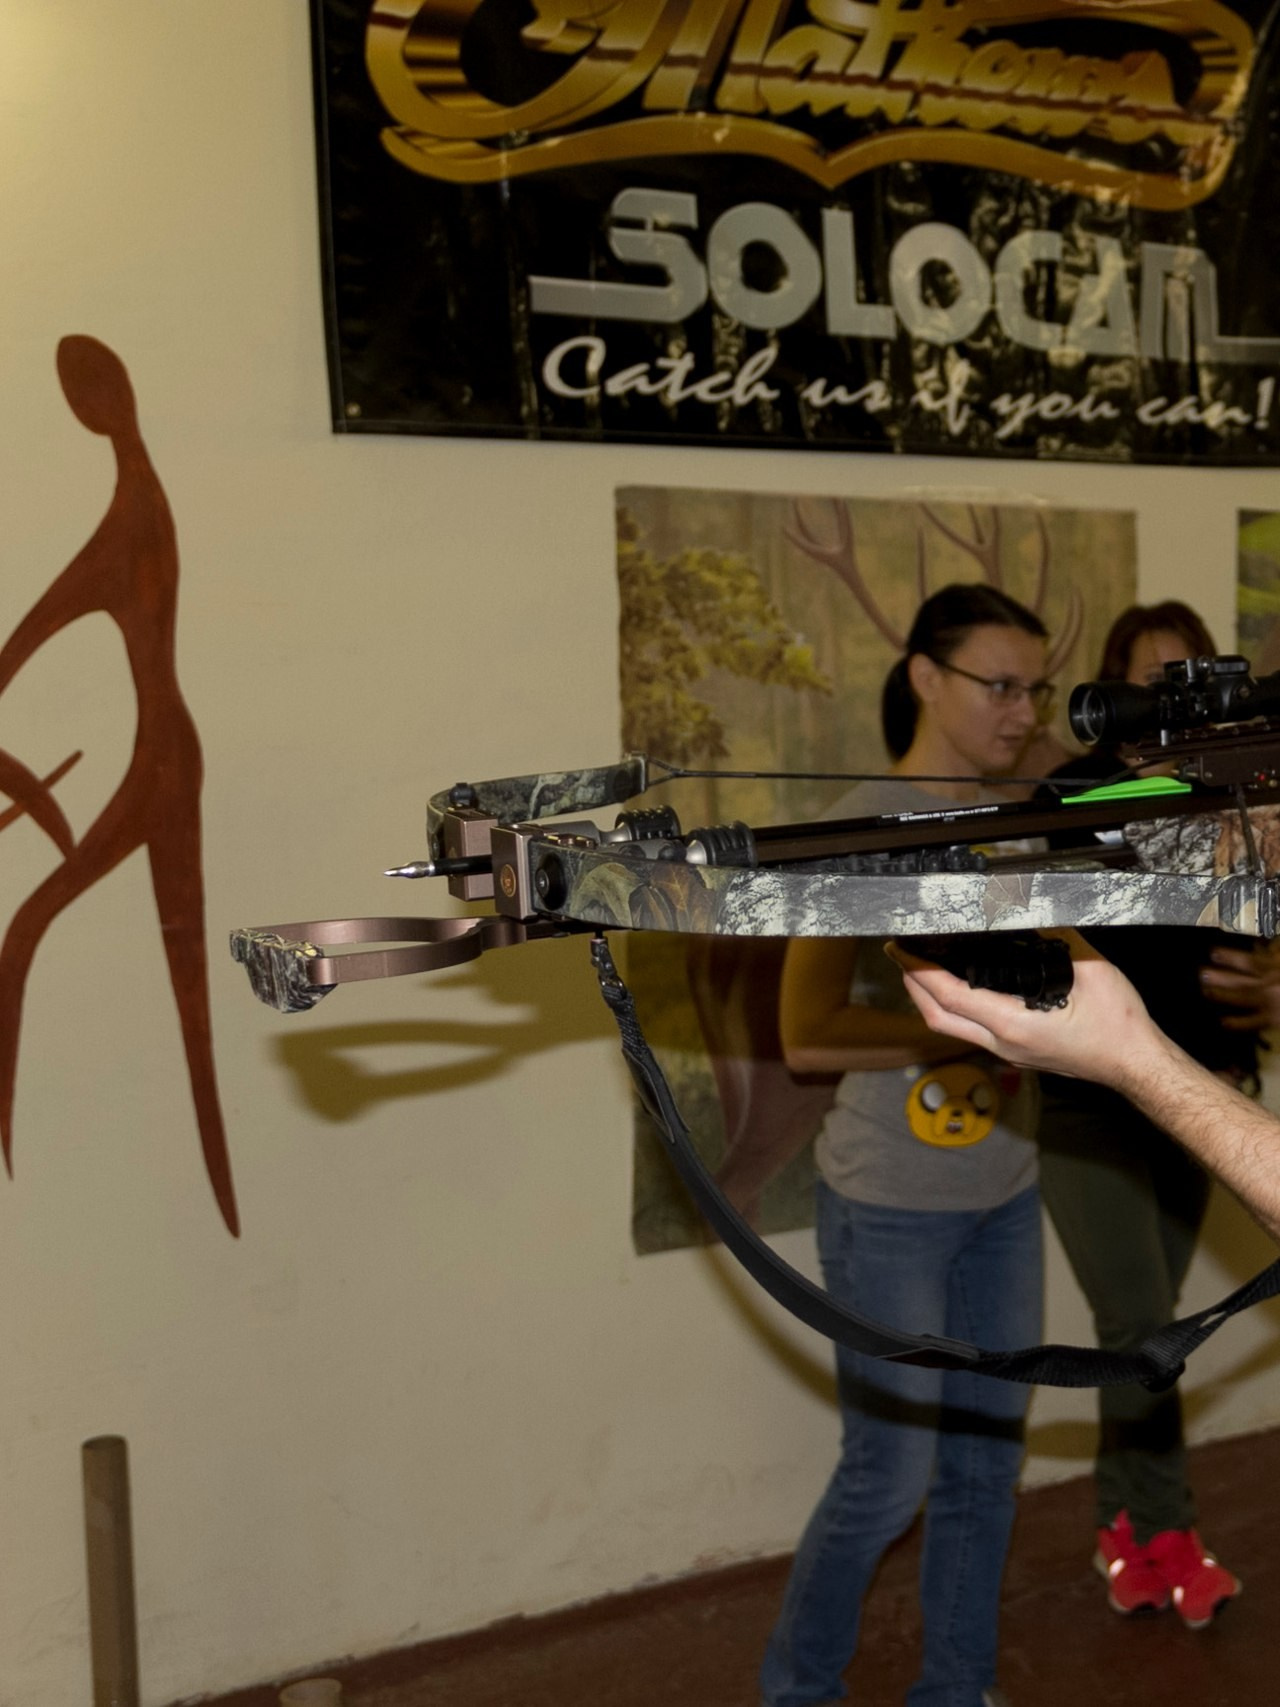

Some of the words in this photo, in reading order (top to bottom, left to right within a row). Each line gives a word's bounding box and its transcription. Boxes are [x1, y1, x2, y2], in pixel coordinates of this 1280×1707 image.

[543, 336, 780, 406] Catch
[802, 377, 893, 412] us
[908, 360, 975, 446] if
[990, 390, 1122, 449] you
[1136, 376, 1276, 430] can!
